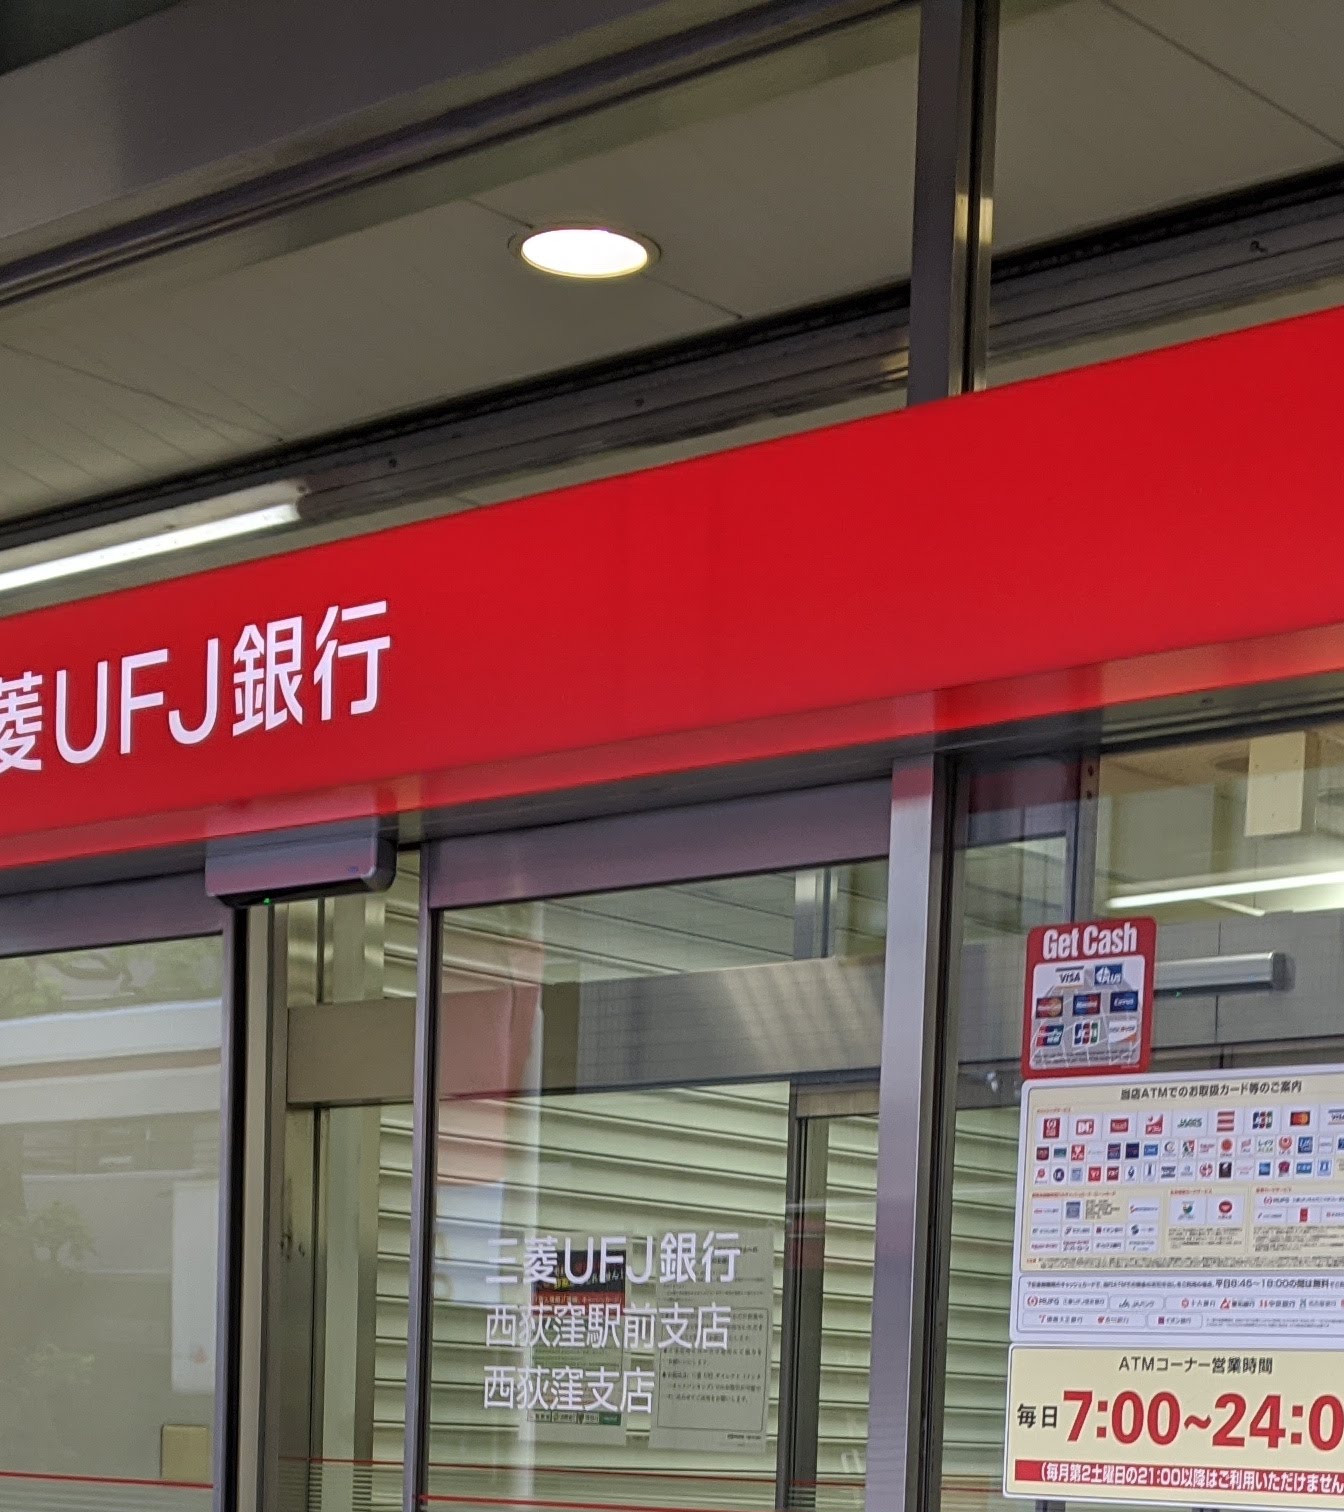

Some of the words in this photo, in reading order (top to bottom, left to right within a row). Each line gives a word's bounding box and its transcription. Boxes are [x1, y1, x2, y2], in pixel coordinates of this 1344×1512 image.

[1043, 927, 1079, 960] Get
[1083, 922, 1137, 956] Cash
[485, 1231, 741, 1285] 三菱UFJ銀行
[485, 1301, 732, 1351] 西荻窪駅前支店
[1119, 1356, 1273, 1375] ATMコーナー営業時間
[483, 1365, 655, 1414] 西荻窪支店
[1017, 1403, 1058, 1429] 毎日
